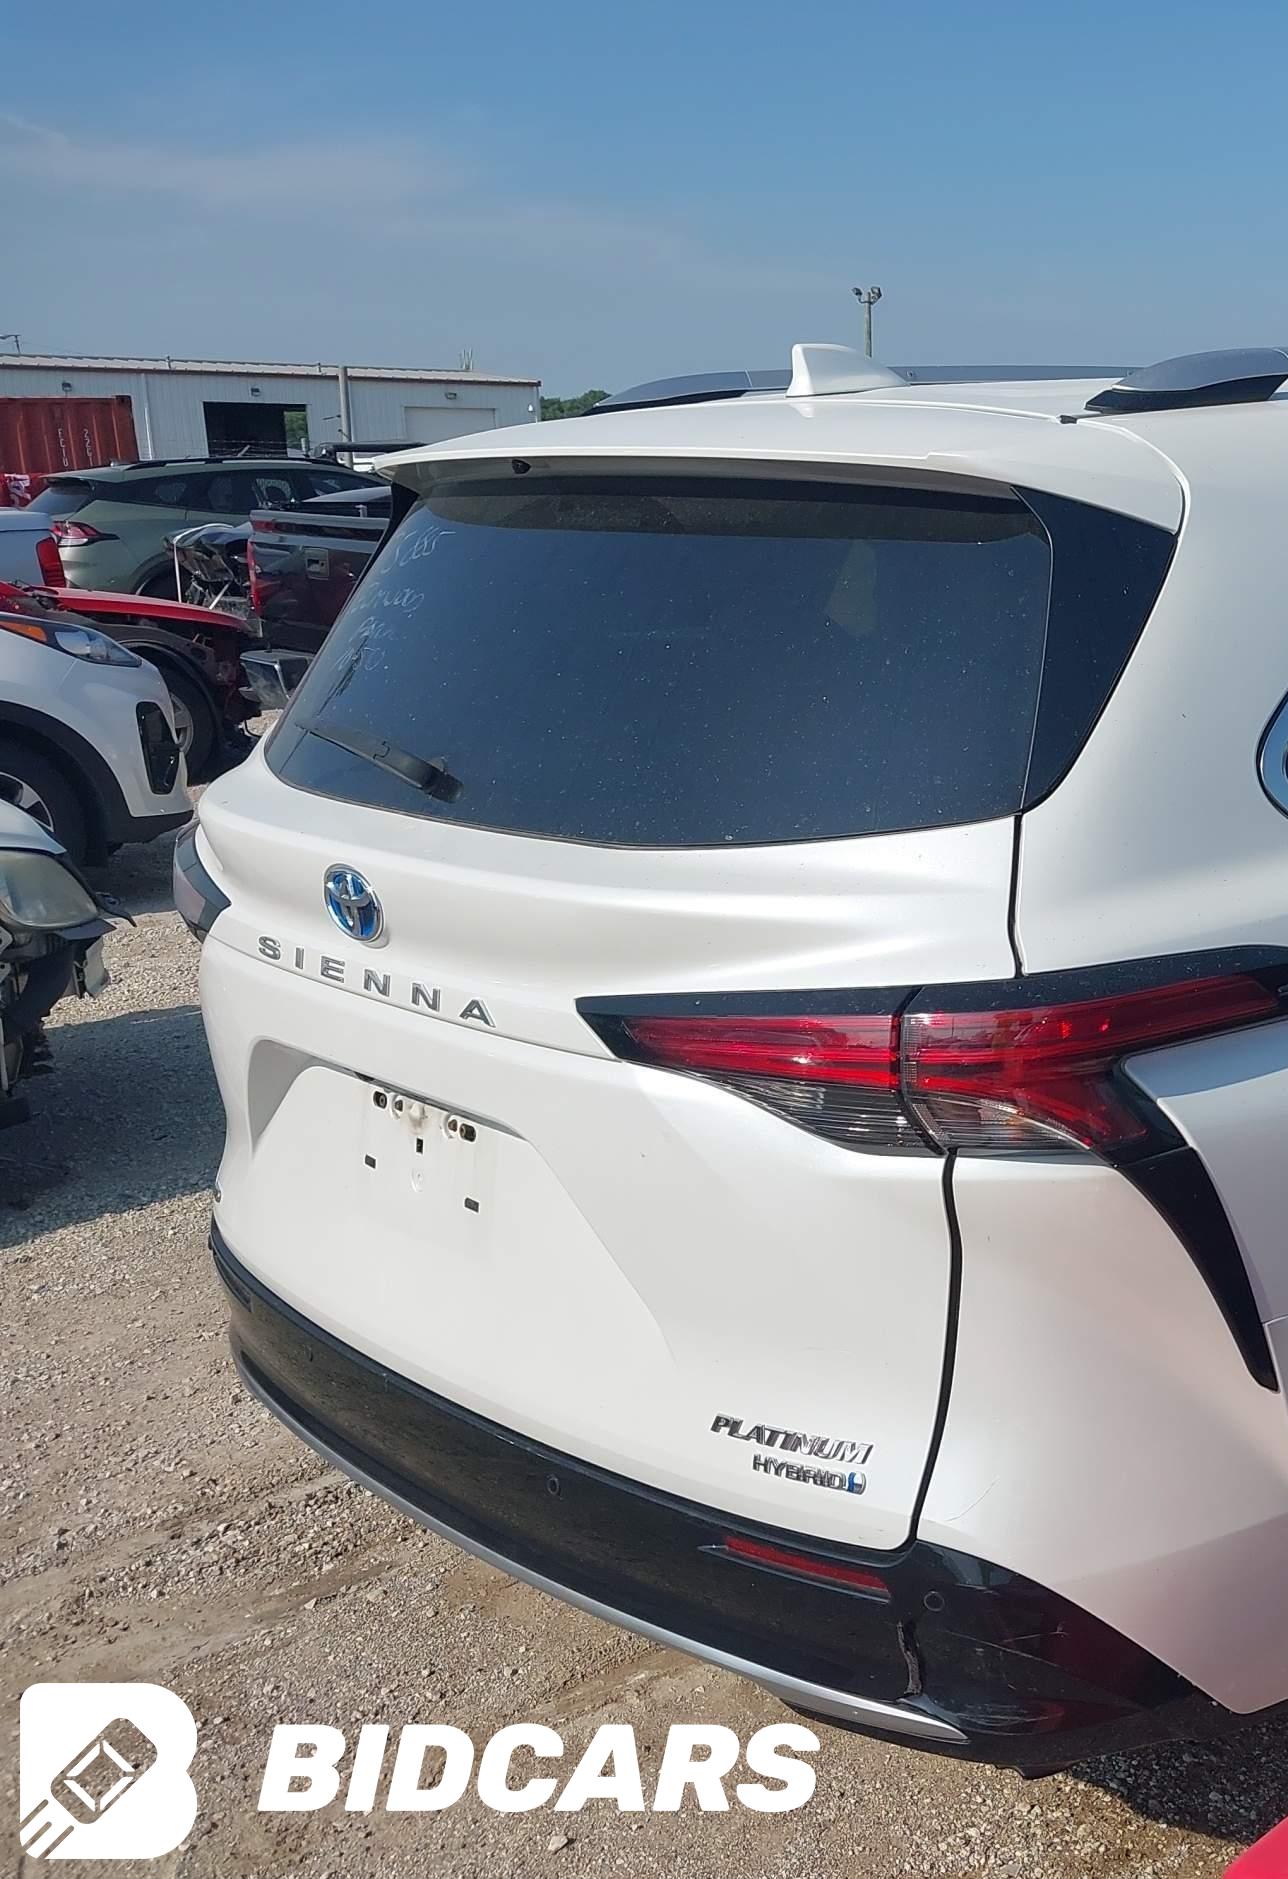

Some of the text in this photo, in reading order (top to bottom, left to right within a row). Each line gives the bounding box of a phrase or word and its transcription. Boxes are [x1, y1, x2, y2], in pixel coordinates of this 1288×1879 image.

[257, 936, 496, 1028] SIENNA
[710, 1413, 873, 1465] PLATINUM
[752, 1453, 846, 1494] HYBRID
